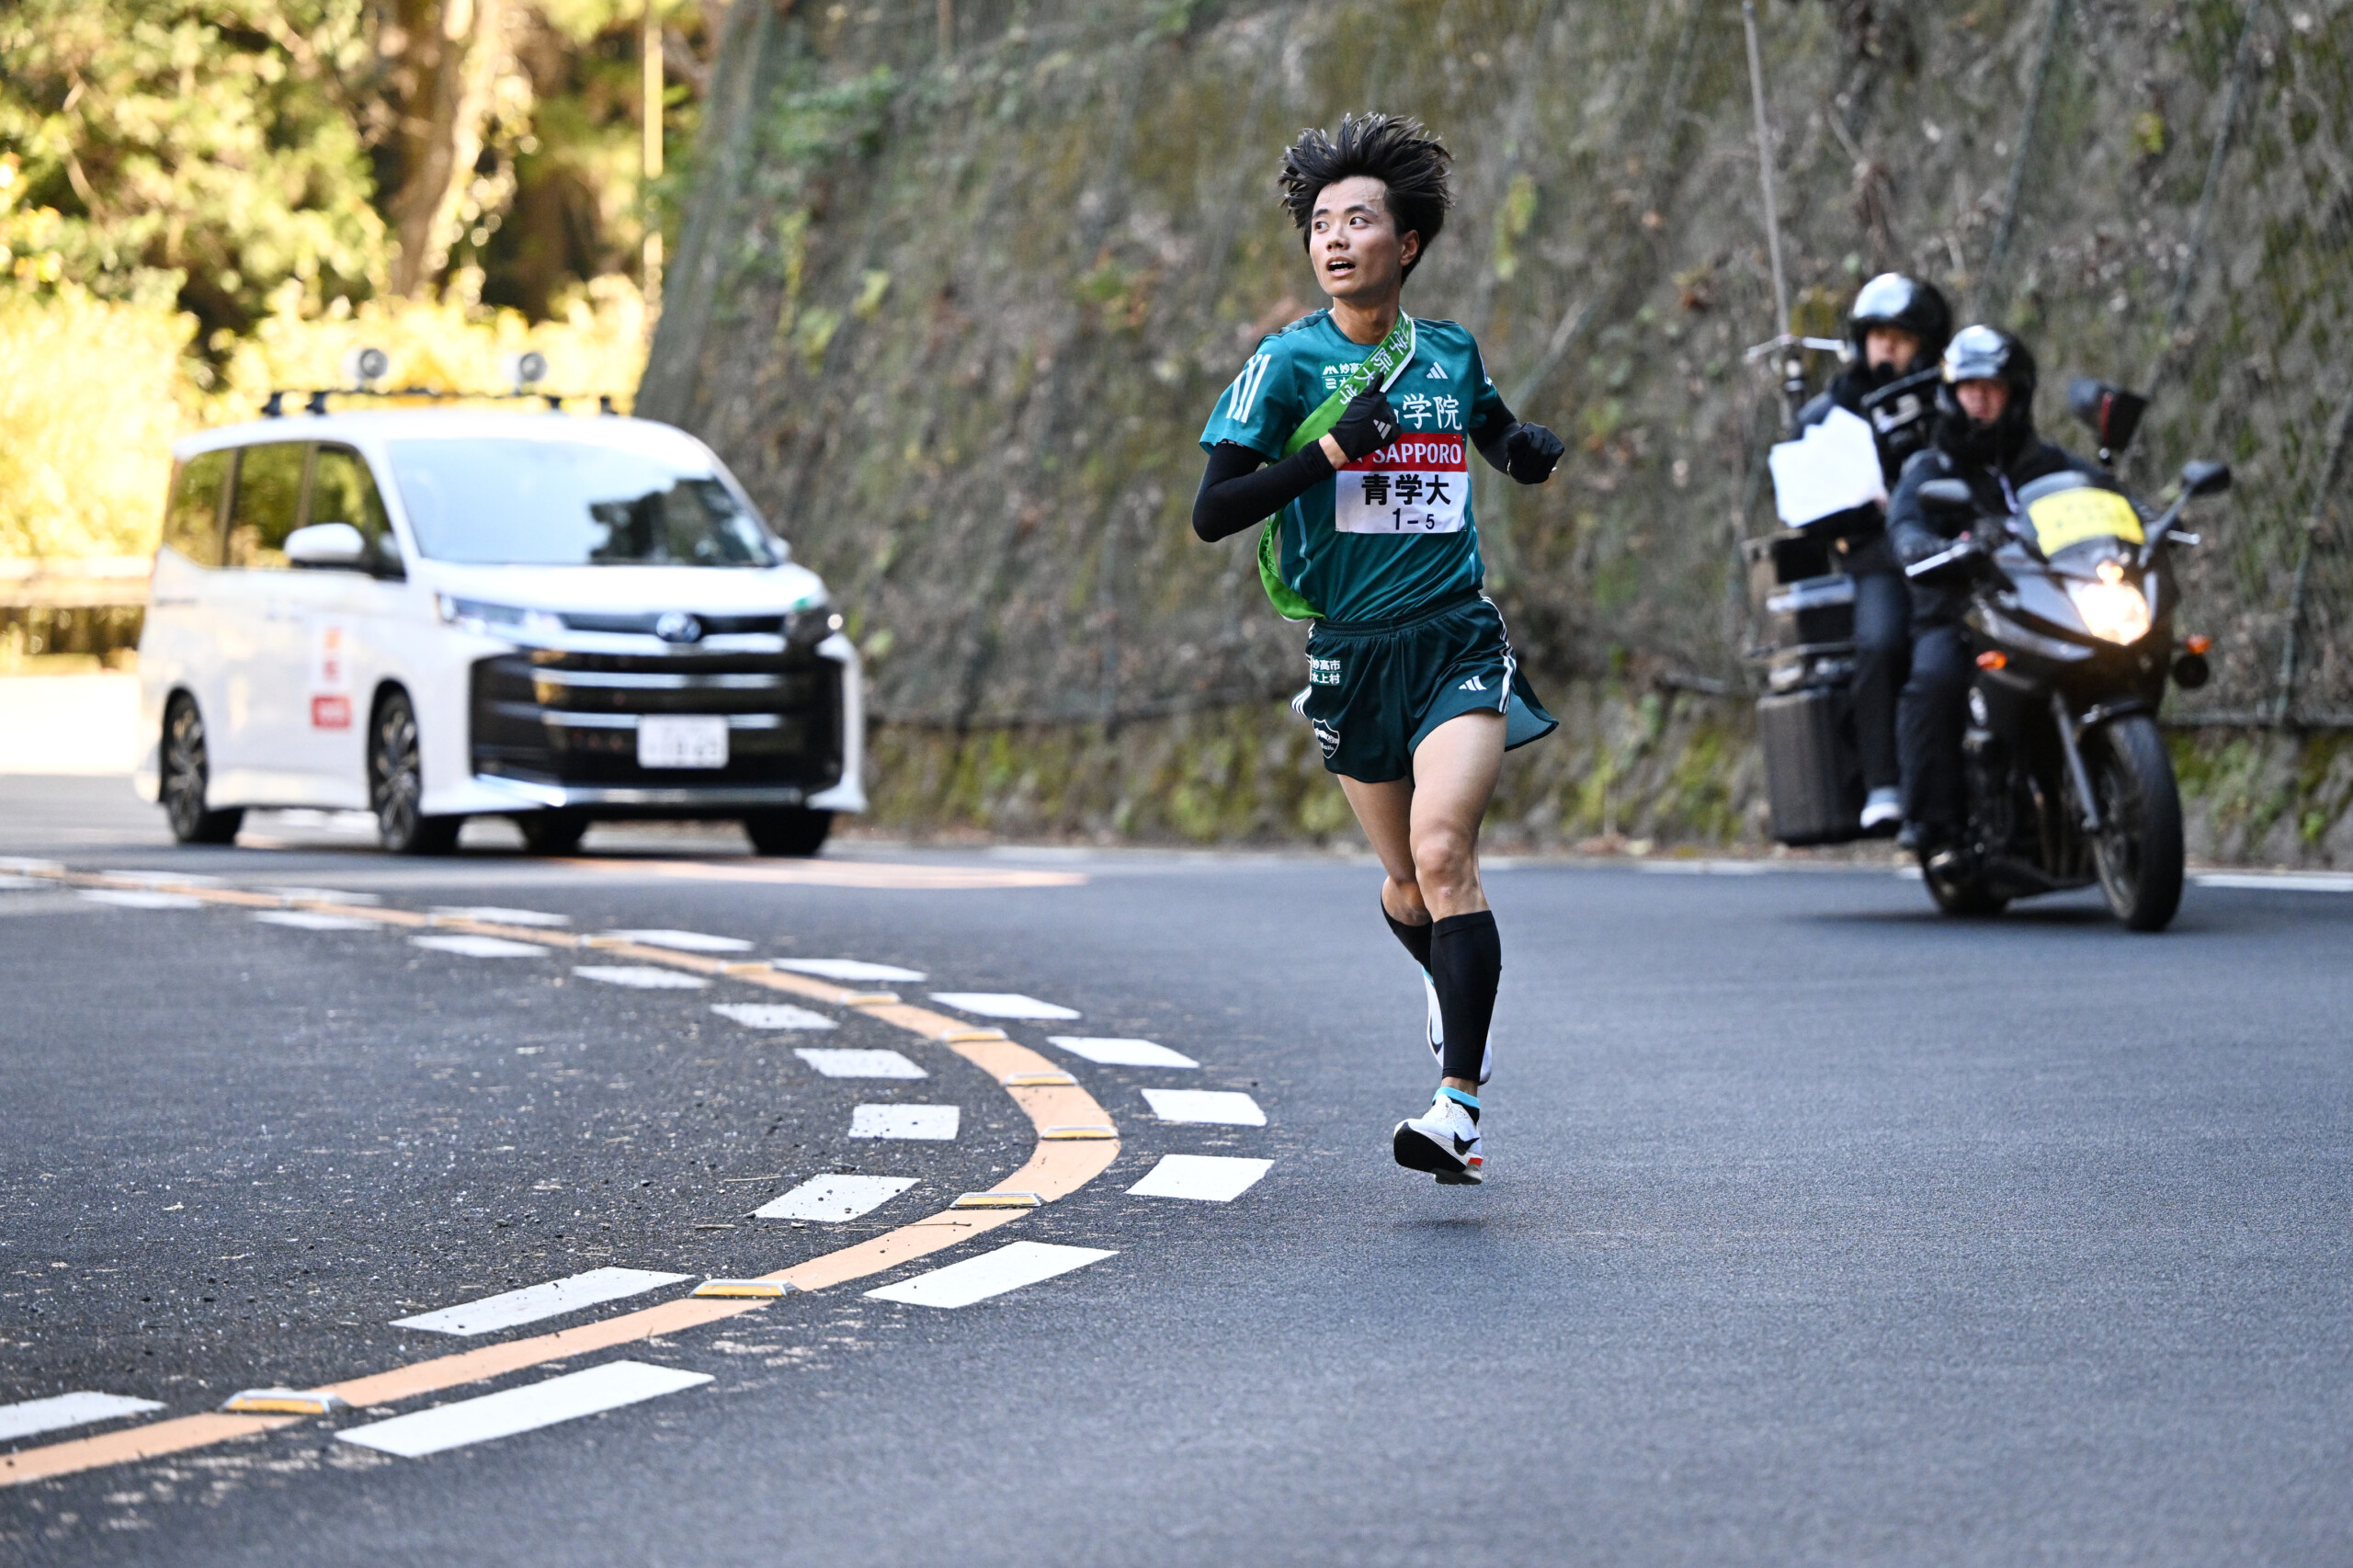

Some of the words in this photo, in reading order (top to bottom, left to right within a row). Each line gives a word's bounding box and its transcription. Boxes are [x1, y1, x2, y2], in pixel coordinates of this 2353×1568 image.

[1393, 393, 1462, 430] 学院
[1373, 443, 1462, 464] SAPPORO
[1361, 473, 1451, 506] 青学大
